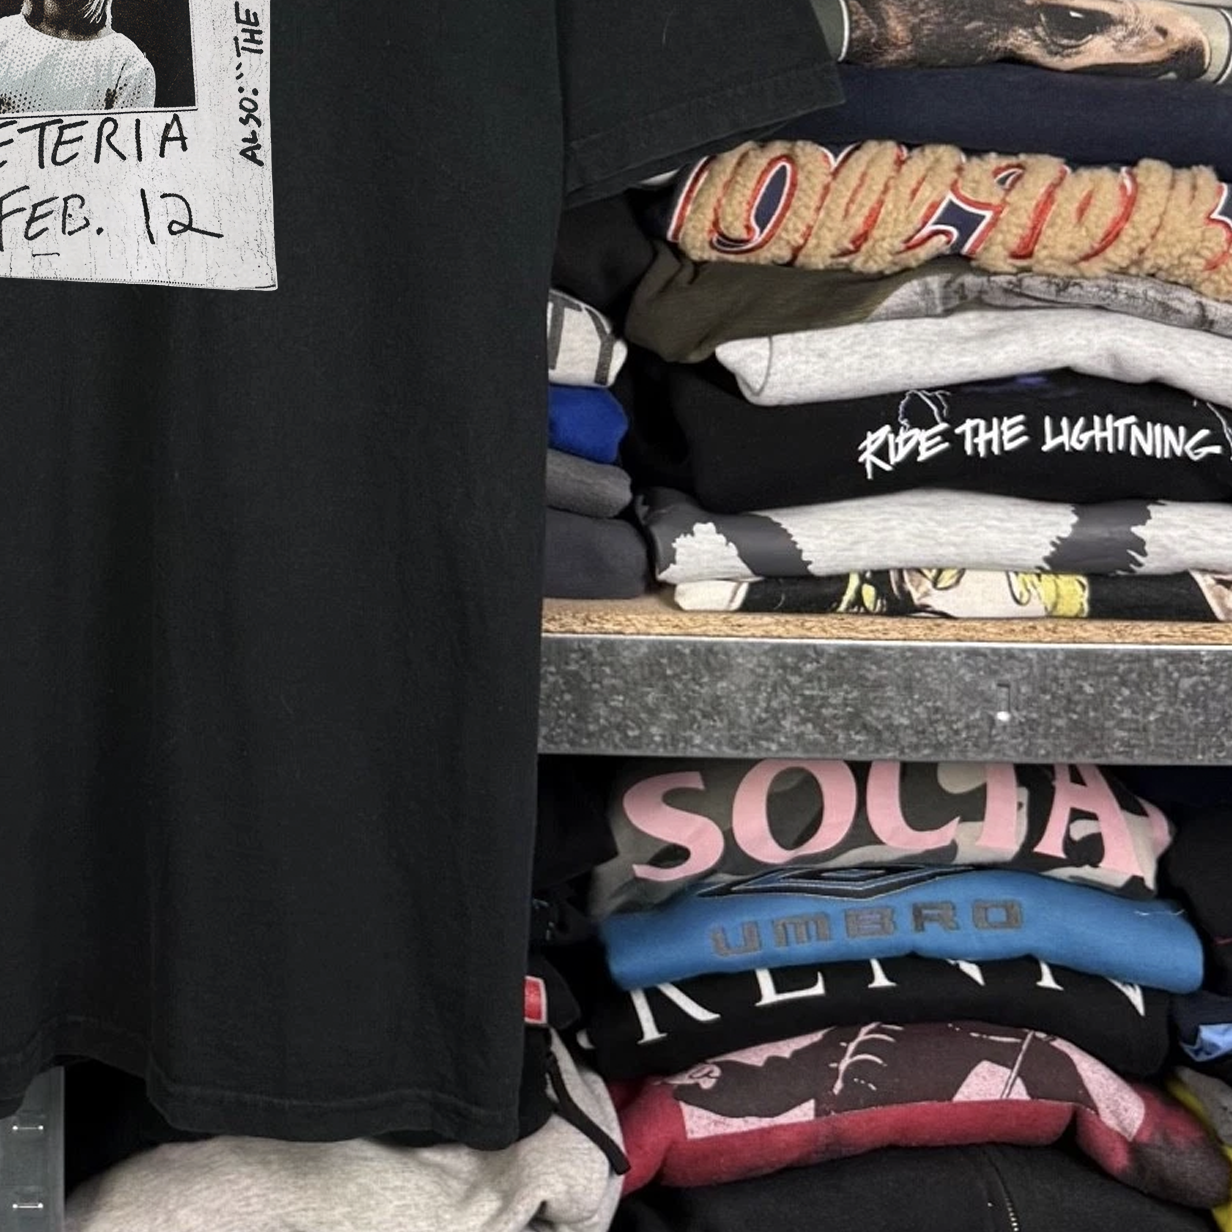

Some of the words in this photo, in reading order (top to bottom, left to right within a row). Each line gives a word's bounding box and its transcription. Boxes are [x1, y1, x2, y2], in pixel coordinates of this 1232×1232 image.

[140, 188, 225, 245] 12
[858, 422, 952, 480] RIDE
[954, 414, 1031, 458] THE
[1040, 413, 1224, 461] LIGHTNING
[710, 899, 1024, 959] UMBRO
